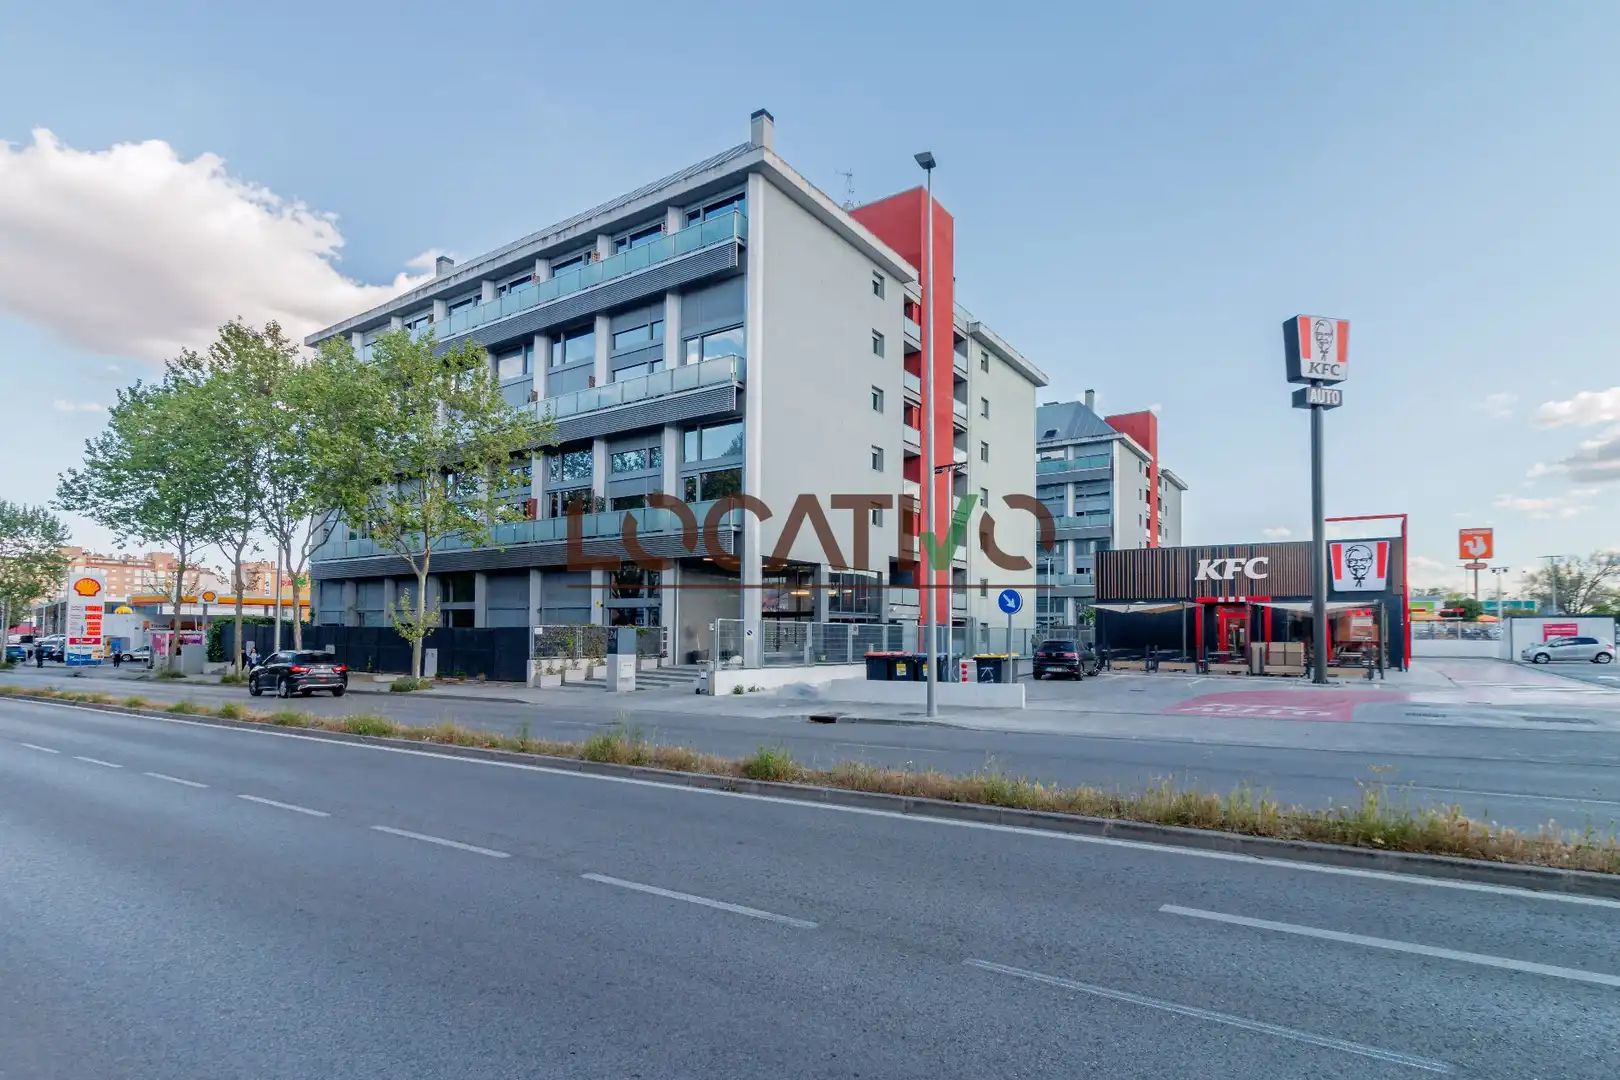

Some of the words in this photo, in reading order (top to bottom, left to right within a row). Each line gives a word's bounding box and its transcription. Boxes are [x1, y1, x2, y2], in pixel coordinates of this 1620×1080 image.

[1308, 361, 1341, 377] KFC
[1310, 388, 1340, 404] AUTO
[1194, 556, 1269, 581] KFC
